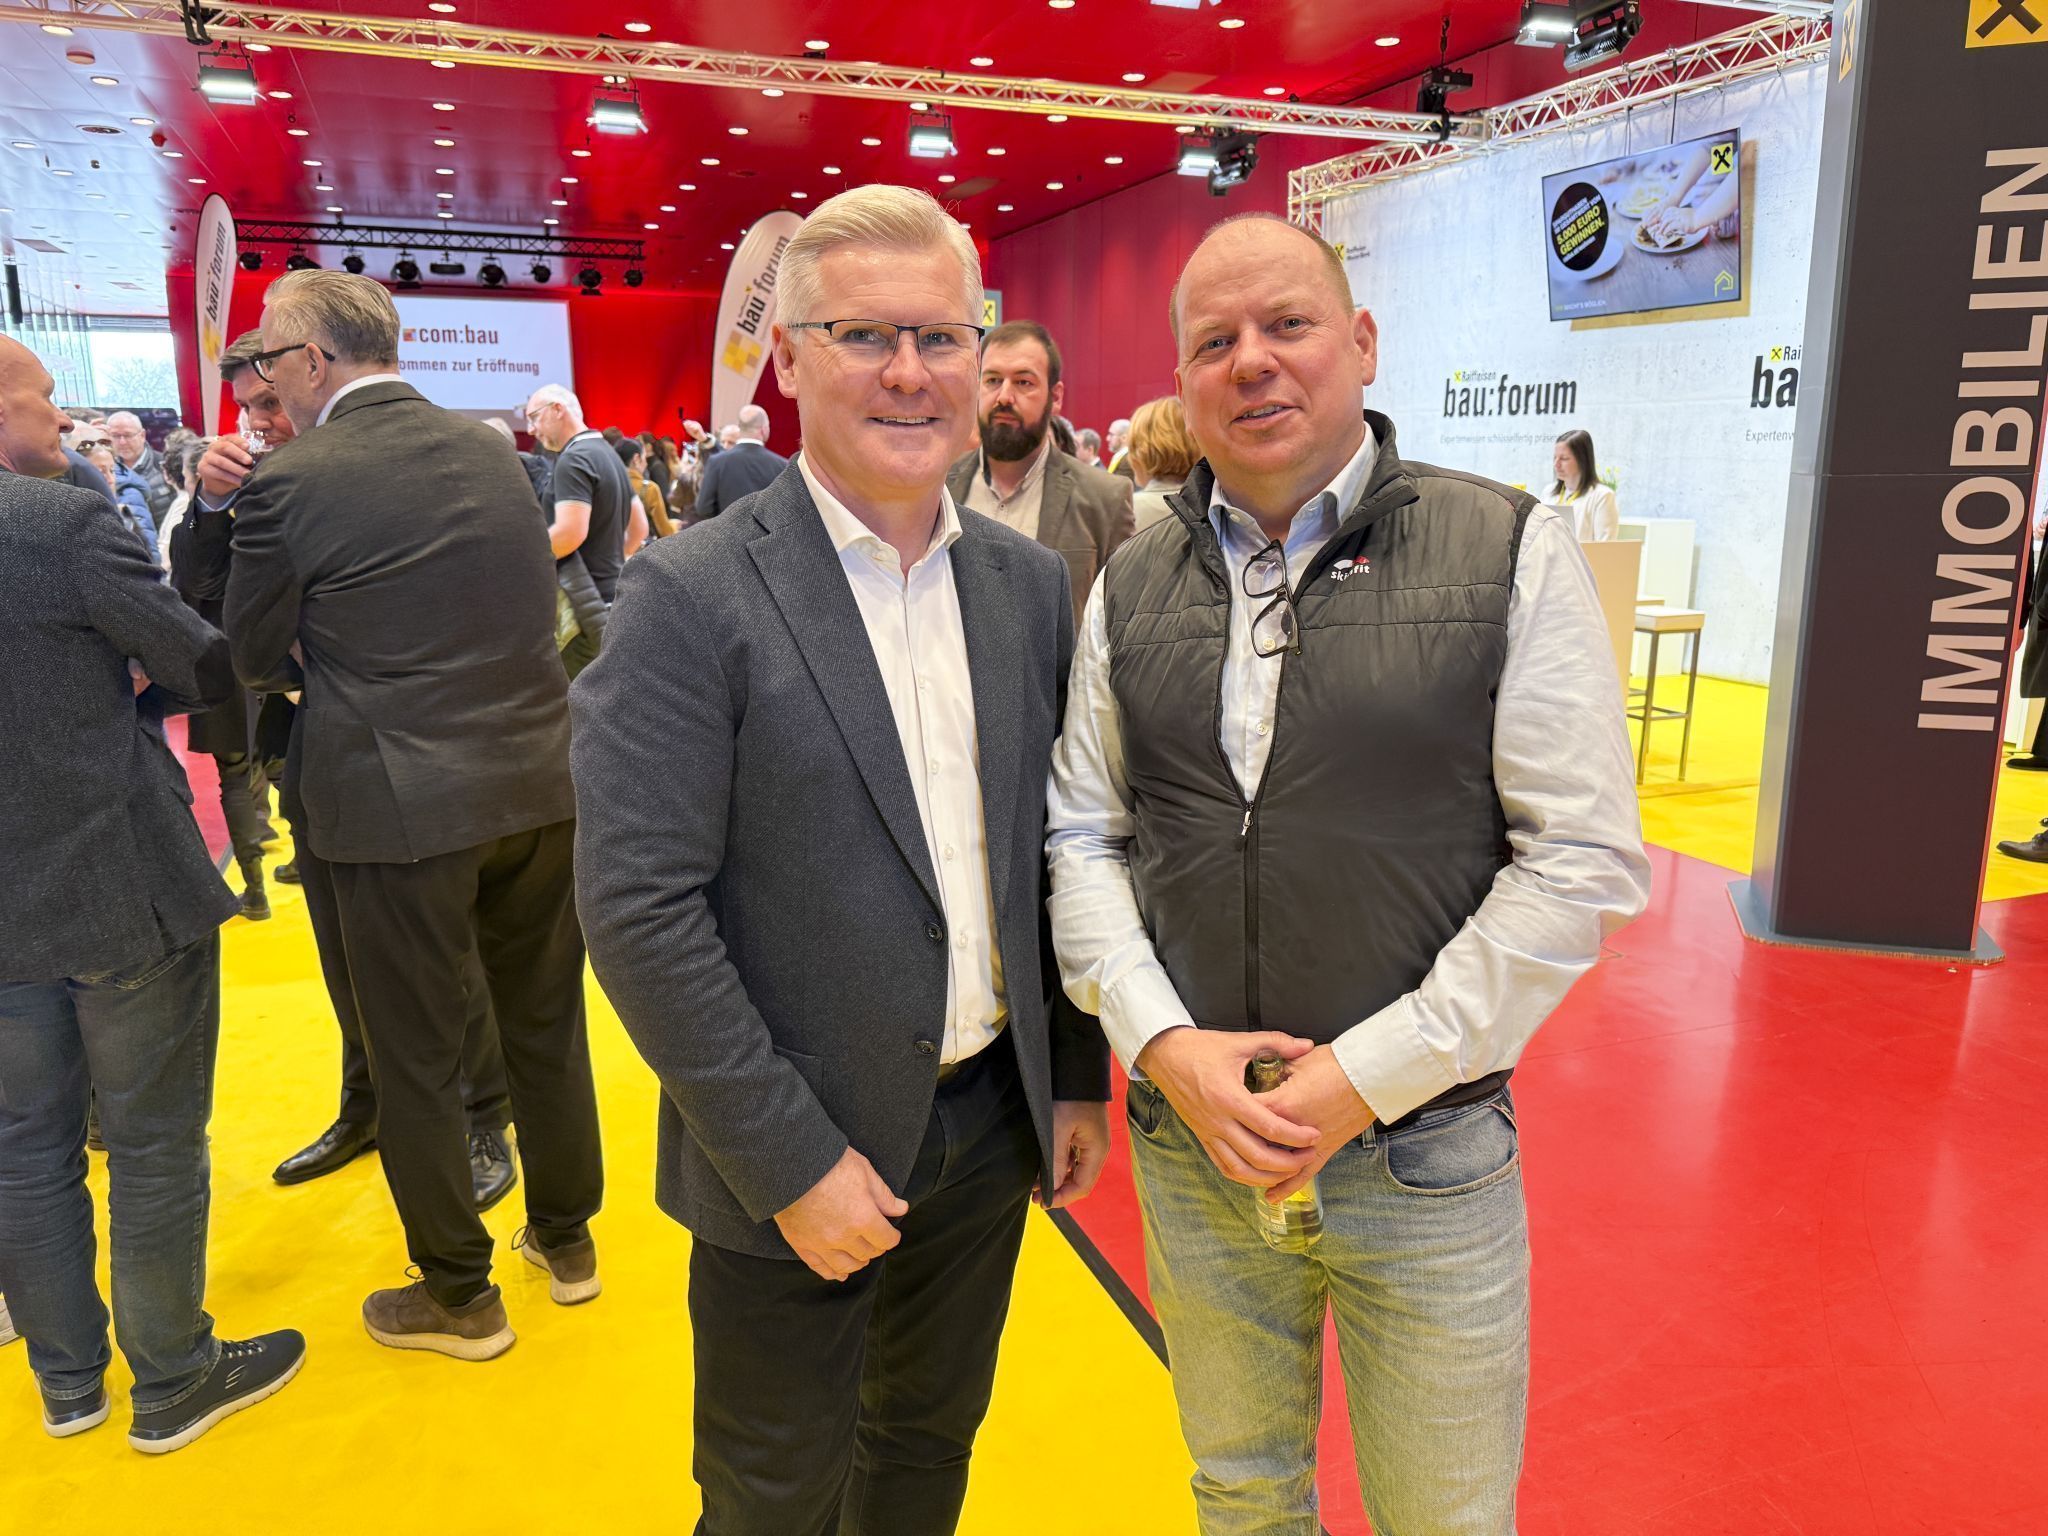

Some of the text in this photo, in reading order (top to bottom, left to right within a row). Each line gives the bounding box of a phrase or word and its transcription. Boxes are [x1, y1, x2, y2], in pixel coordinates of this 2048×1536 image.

[1557, 222, 1577, 245] 5.000
[1577, 205, 1600, 229] EURO
[1560, 217, 1605, 255] GEWINNEN.
[419, 324, 499, 344] com:bau
[1783, 345, 1802, 361] Rai
[398, 358, 540, 376] ommen zur Eröffnung
[1750, 355, 1799, 408] ba
[1443, 374, 1577, 418] bau:forum
[1917, 146, 2048, 731] IMMOBILIEN
